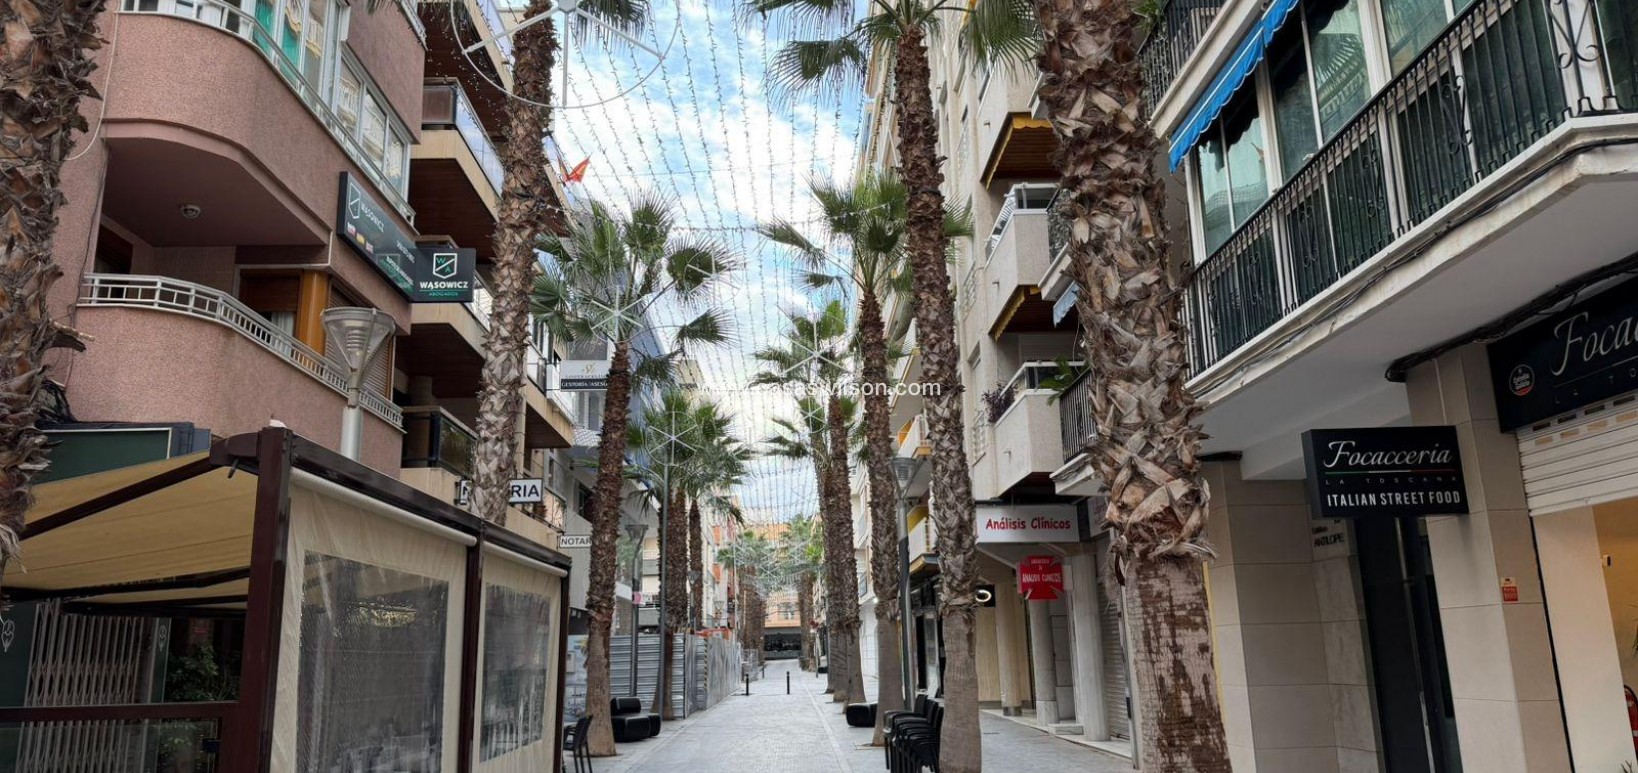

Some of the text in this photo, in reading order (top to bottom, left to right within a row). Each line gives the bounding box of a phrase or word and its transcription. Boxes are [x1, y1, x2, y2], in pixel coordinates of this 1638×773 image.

[420, 281, 468, 289] WĄSOWICZ
[1550, 312, 1638, 375] Foca
[1324, 441, 1450, 468] Focacceria
[1327, 491, 1460, 507] ITALIAN STREET FOOD
[986, 516, 1070, 530] Análisis Clínicos
